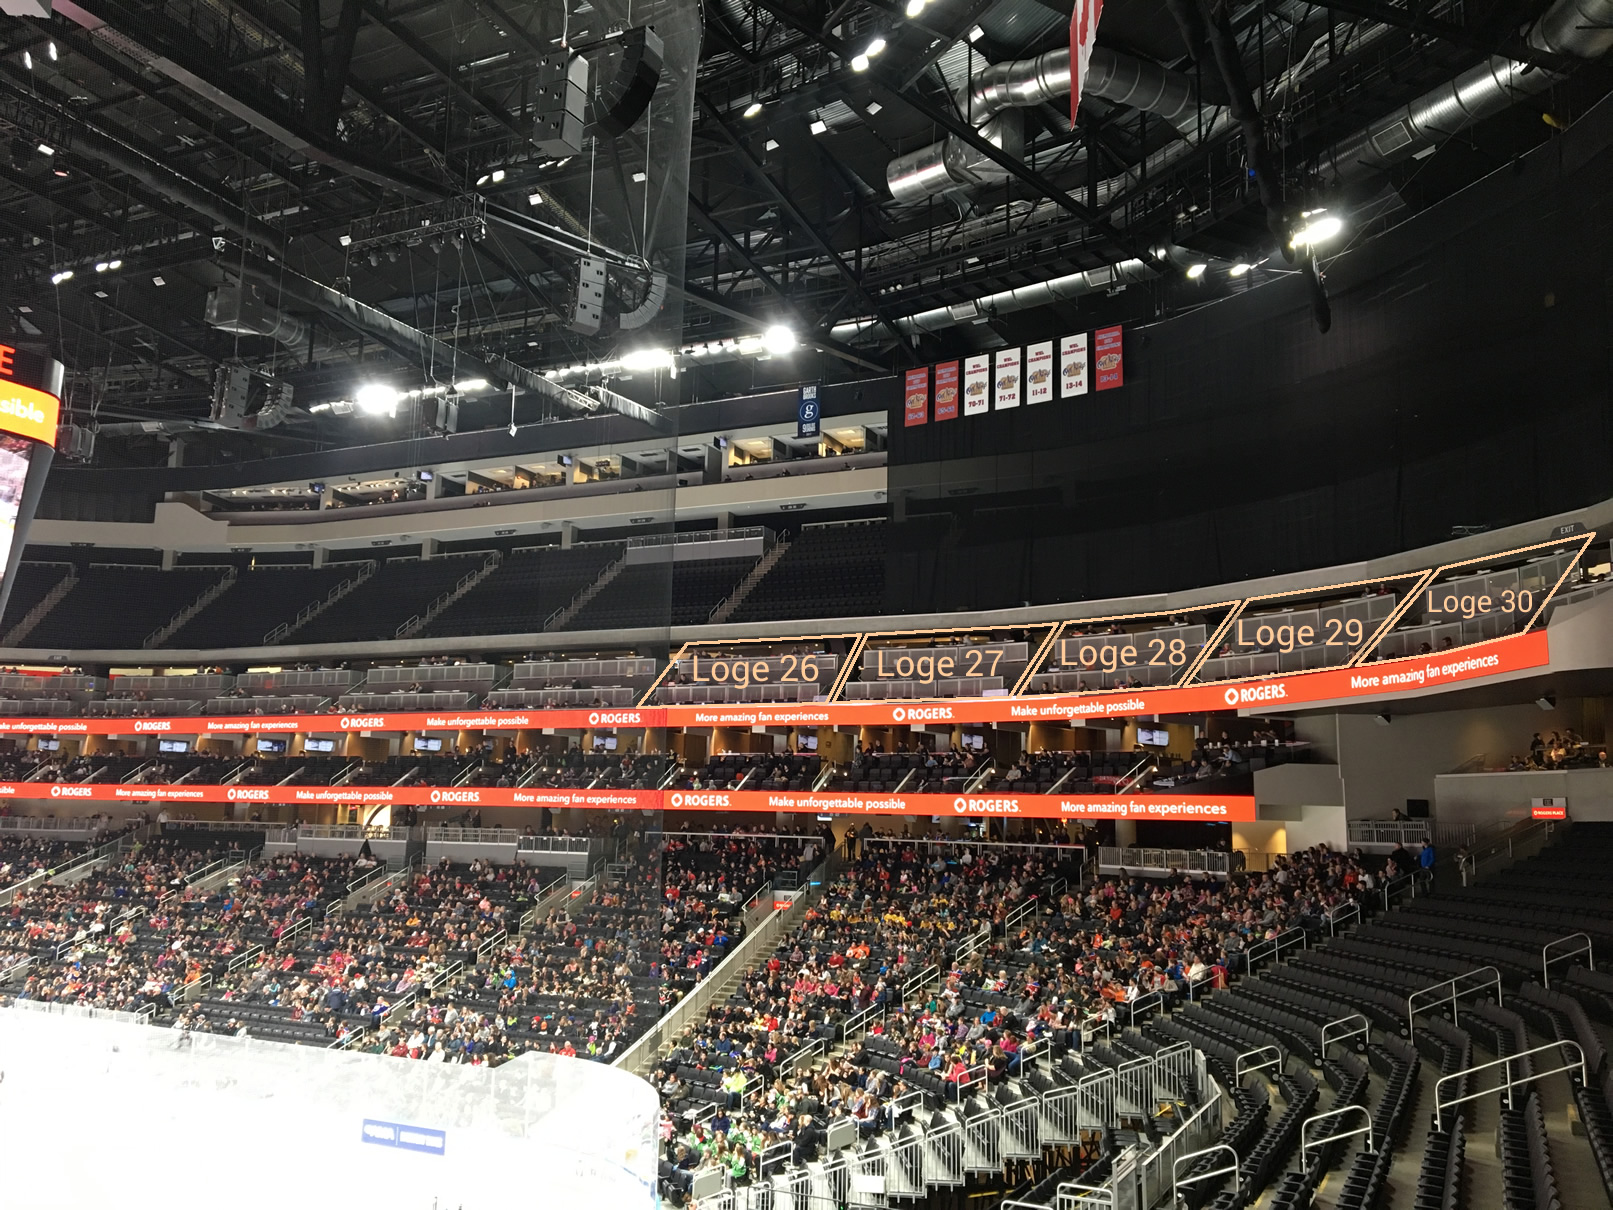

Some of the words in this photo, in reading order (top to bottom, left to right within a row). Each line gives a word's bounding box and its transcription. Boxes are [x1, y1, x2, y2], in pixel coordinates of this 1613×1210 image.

[1066, 381, 1082, 389] 13-14
[999, 393, 1016, 402] 71-72
[1032, 388, 1047, 396] 11-12
[968, 399, 984, 407] 70-71
[0, 398, 45, 423] sible
[1560, 525, 1574, 534] EXIT
[1352, 676, 1379, 688] More
[1382, 669, 1424, 685] amazing
[1426, 664, 1440, 678] fan
[1441, 654, 1498, 676] experiences
[1012, 705, 1037, 716] Make
[1040, 703, 1104, 717] unforgettable
[1106, 698, 1144, 714] possible
[427, 718, 446, 726] Make
[448, 717, 496, 728] unforgettable
[498, 716, 528, 727] possible
[696, 714, 718, 722] More
[720, 713, 756, 724] amazing
[758, 712, 772, 721] fan
[774, 712, 828, 723] experiences
[12, 722, 57, 732] unforgettable
[58, 723, 87, 732] possible
[132, 790, 156, 798] amazing
[168, 790, 203, 798] experiences
[296, 791, 314, 799] Make
[316, 790, 362, 802] unforgettable
[363, 792, 393, 802] possible
[514, 793, 534, 802] More
[536, 794, 570, 805] amazing
[572, 794, 584, 803] fan
[586, 795, 636, 805] experiences
[769, 796, 794, 806] Make
[797, 796, 863, 810] unforgettable
[866, 798, 905, 811] possible
[1061, 802, 1085, 812] More
[1087, 802, 1127, 816] amazing
[1130, 801, 1145, 812] fan
[1148, 802, 1226, 816] experiences
